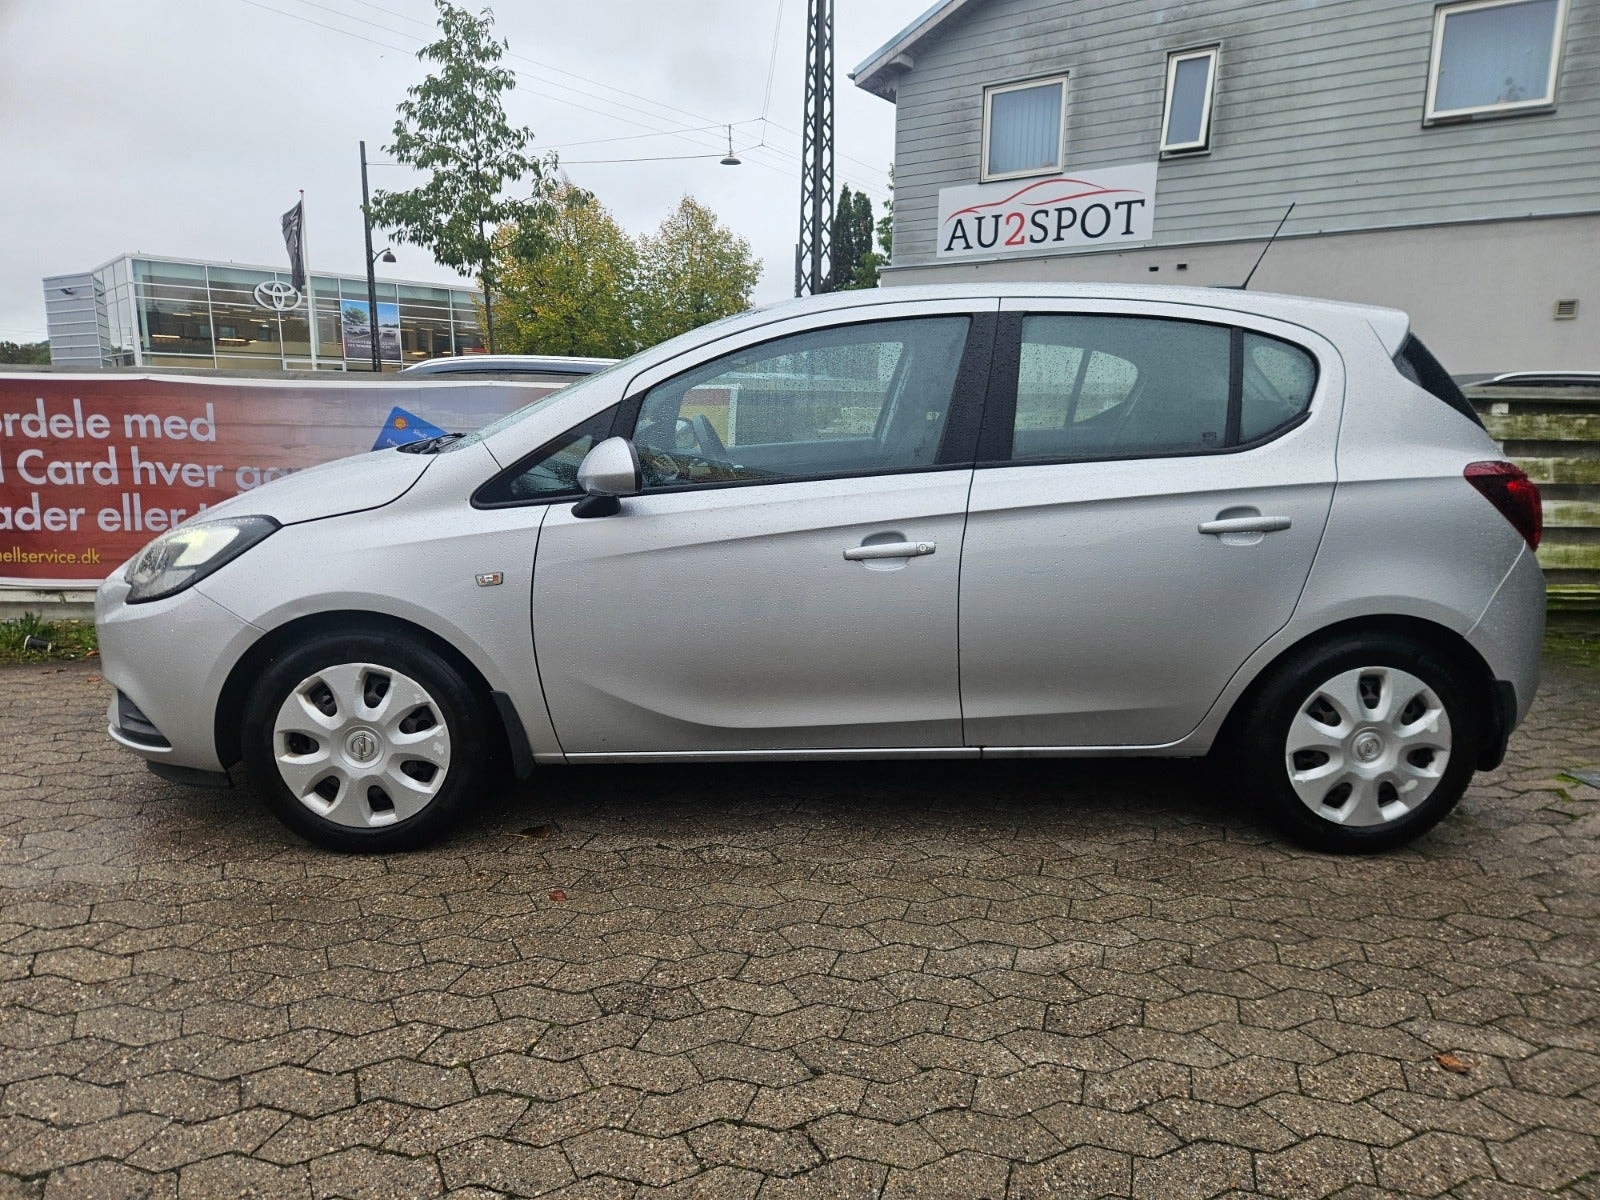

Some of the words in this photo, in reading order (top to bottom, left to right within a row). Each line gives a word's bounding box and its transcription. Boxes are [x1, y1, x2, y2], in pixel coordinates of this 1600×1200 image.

[944, 199, 1146, 252] AU2SPOT
[0, 398, 111, 439] rdele
[123, 402, 216, 442] med
[16, 446, 120, 486] Card
[130, 446, 224, 488] hver
[97, 492, 187, 532] eller
